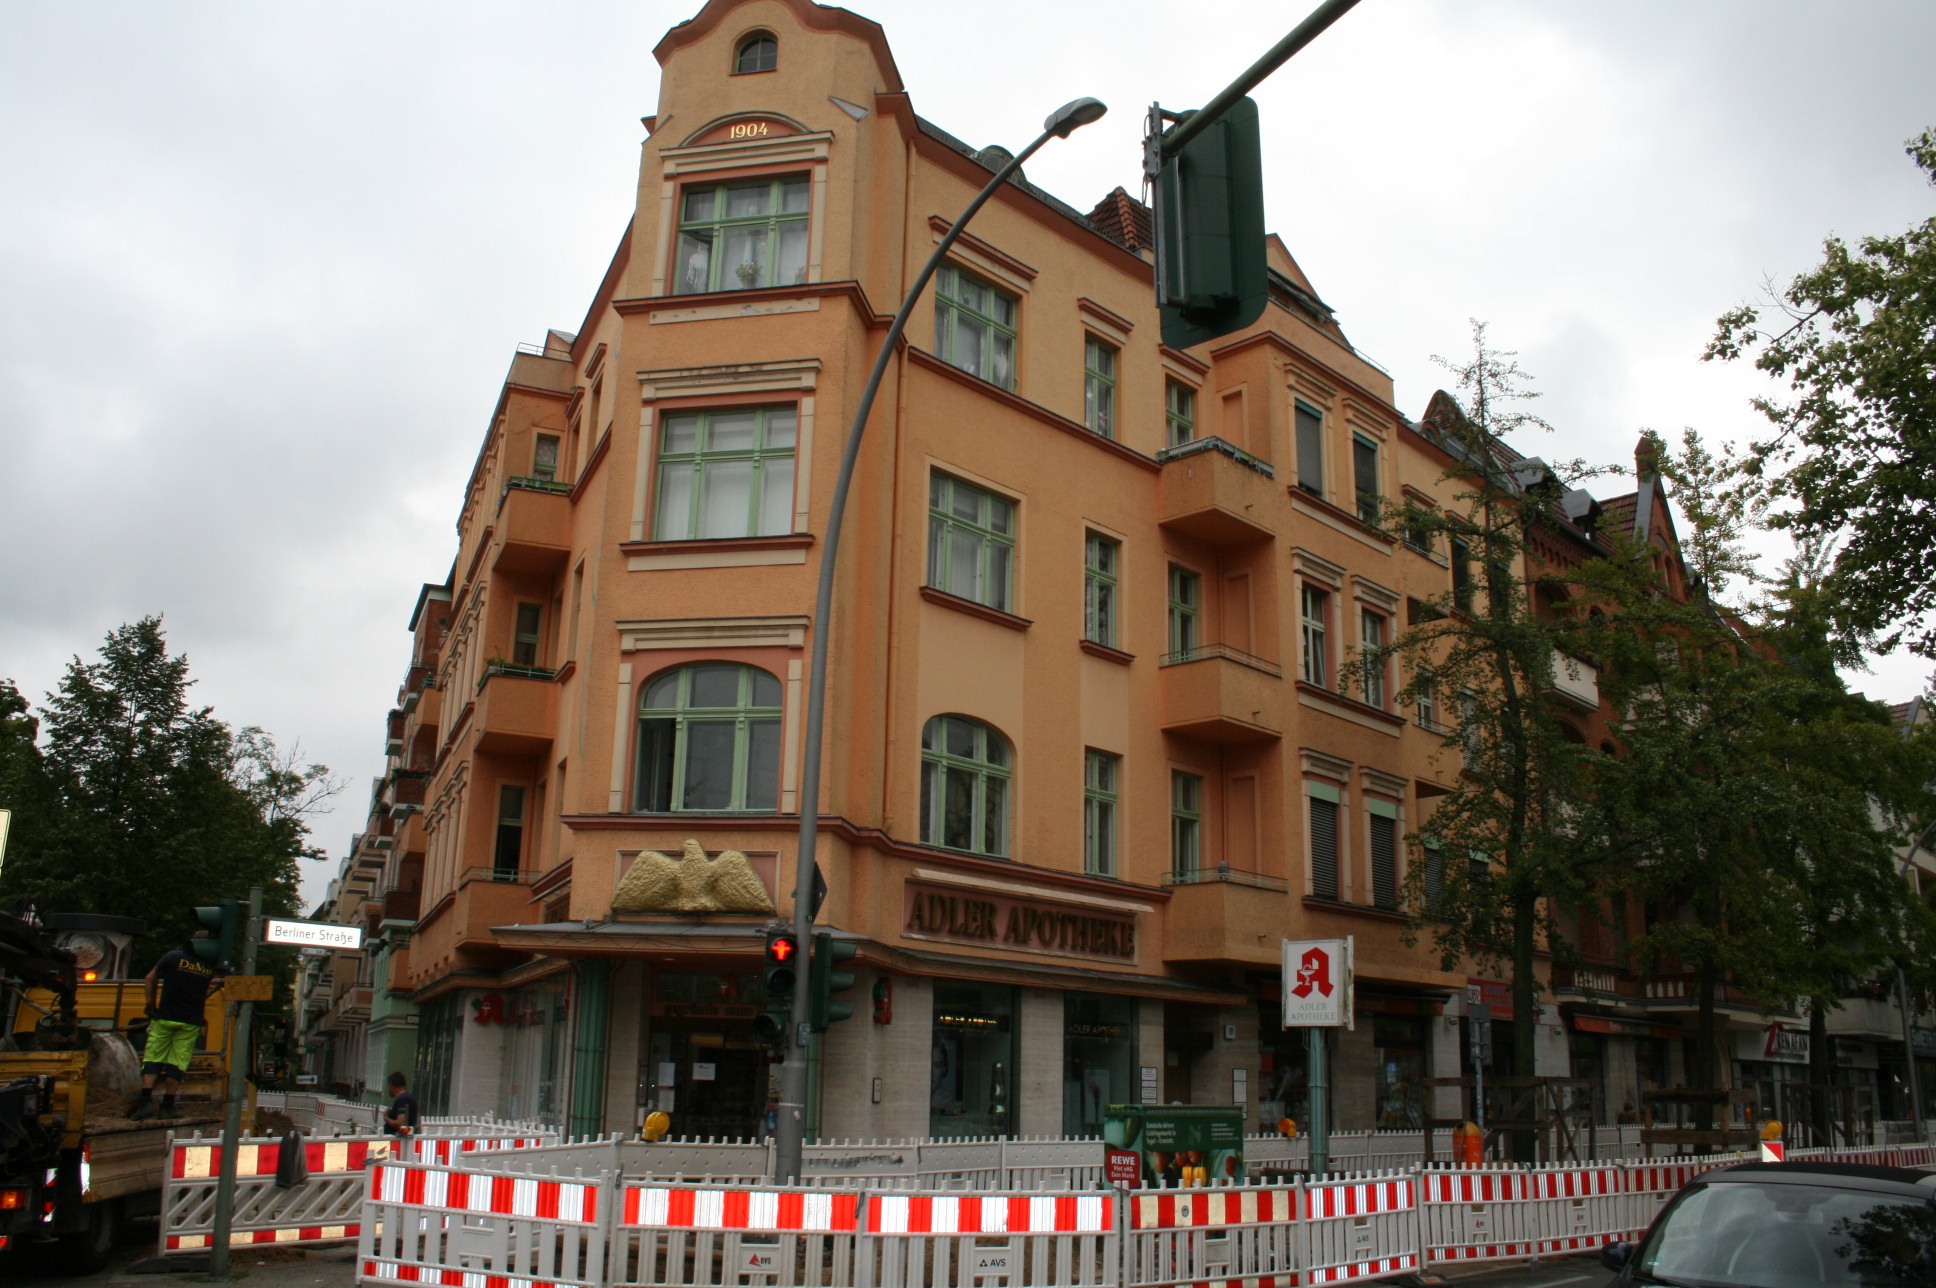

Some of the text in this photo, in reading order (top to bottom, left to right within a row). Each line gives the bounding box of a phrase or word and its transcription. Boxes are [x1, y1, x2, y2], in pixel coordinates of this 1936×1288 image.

[730, 122, 768, 139] 1904
[906, 891, 1136, 956] ADLER APOTHEKE
[274, 925, 354, 945] Berliner Straße
[1290, 1002, 1336, 1021] ADLER APOTHEKE
[1111, 1155, 1136, 1166] REWE
[990, 1258, 1006, 1267] AVS
